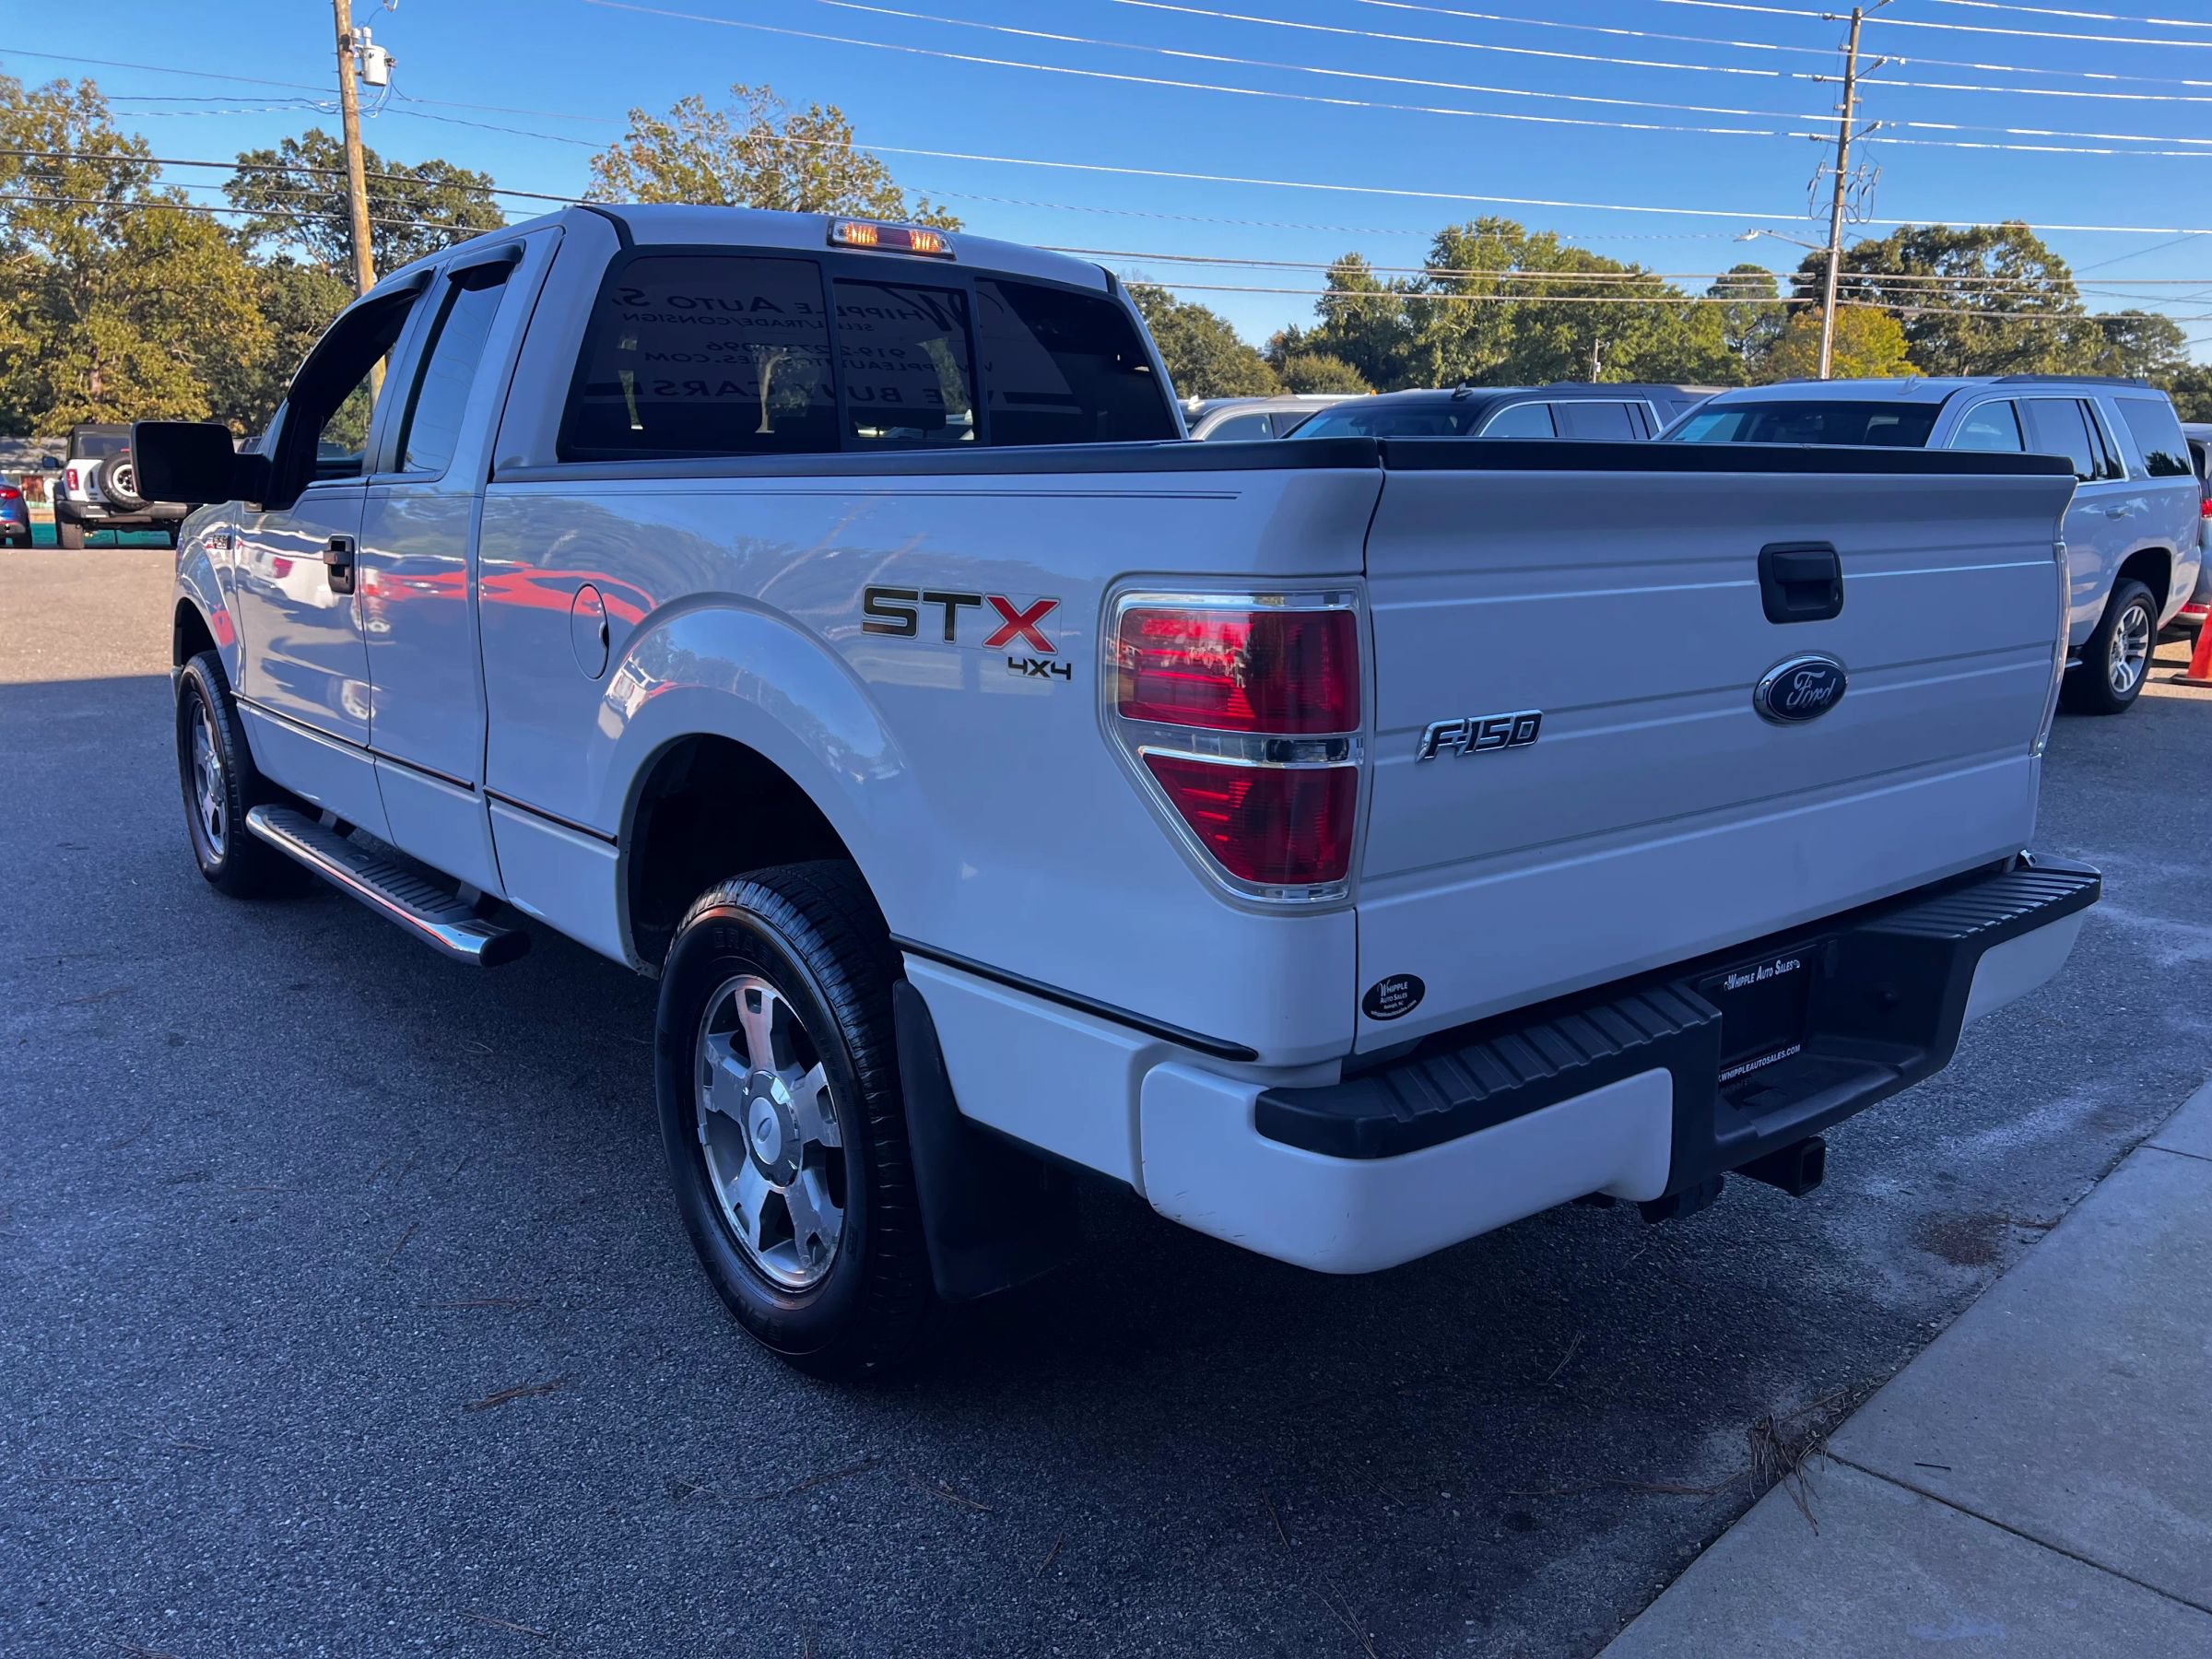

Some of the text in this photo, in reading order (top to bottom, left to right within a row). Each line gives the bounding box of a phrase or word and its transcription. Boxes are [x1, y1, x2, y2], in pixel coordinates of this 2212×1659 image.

[861, 584, 1062, 656] STX
[1785, 669, 1836, 712] Ford
[1416, 708, 1545, 763] F-150
[1376, 979, 1408, 997] WHIPPLE
[1756, 965, 1774, 982] AUTO
[1774, 959, 1794, 976] SALES
